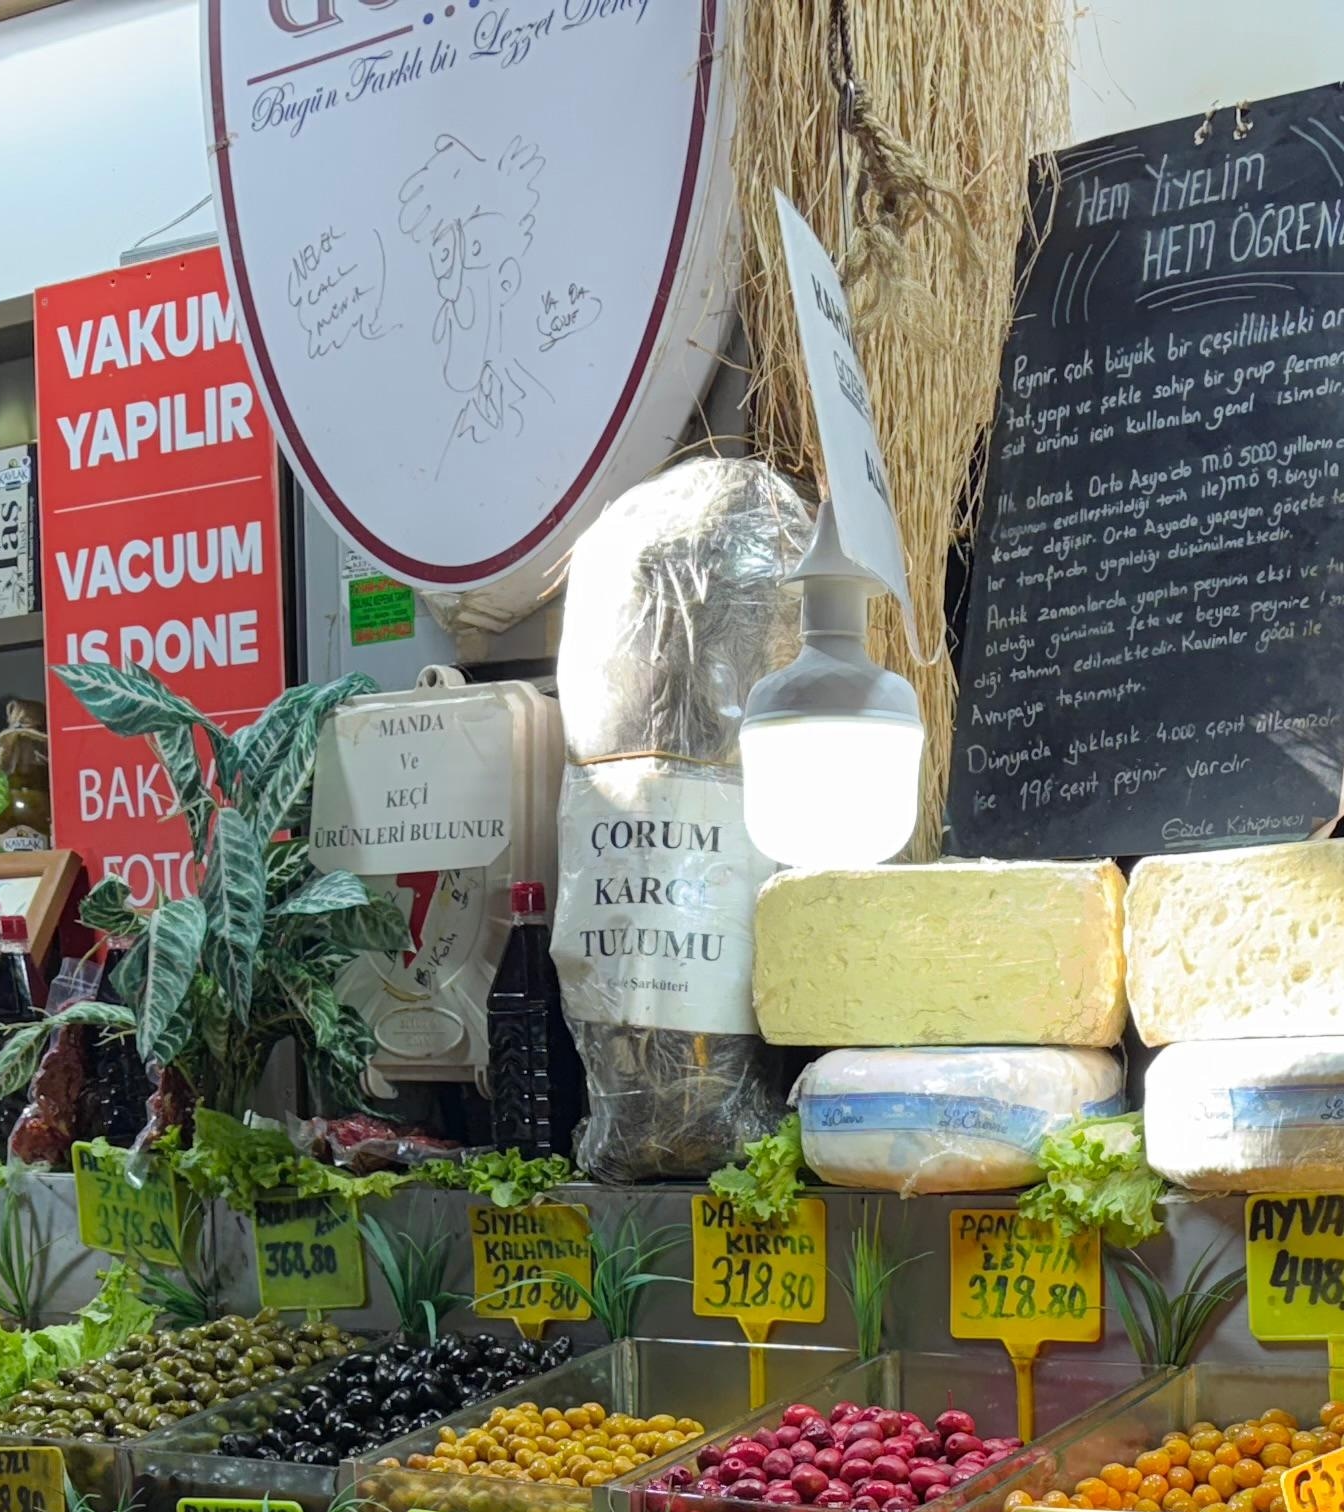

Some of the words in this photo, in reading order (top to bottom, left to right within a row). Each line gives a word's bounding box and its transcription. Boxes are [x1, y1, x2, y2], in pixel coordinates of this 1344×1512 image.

[251, 82, 339, 137] Bugün
[346, 50, 422, 102] Farklı
[431, 41, 457, 77] bir
[470, 8, 555, 68] Lezzet
[1143, 219, 1217, 281] HEM
[1104, 336, 1156, 380] büyük
[1167, 332, 1193, 363] bir
[1075, 397, 1093, 418] ve
[1100, 385, 1143, 418] şekle
[1152, 377, 1196, 405] sahip
[1203, 364, 1225, 391] bir
[1226, 357, 1278, 398] grup
[56, 381, 253, 470] YAPILIR
[1125, 407, 1203, 437] kullanılan
[1204, 391, 1256, 433] genel
[1087, 471, 1125, 500] Orta
[1102, 525, 1138, 546] Orta
[56, 521, 263, 600] VACUUM
[984, 604, 1029, 634] Antik
[1299, 562, 1320, 580] ve
[120, 609, 259, 673] DONE
[984, 636, 1036, 664] olduğu
[1125, 612, 1161, 643] feta
[1164, 609, 1185, 629] ve
[1194, 600, 1242, 631] beyaz
[1180, 627, 1249, 655] Kavimler
[378, 713, 445, 738] MANDA
[400, 752, 419, 770] Ve
[386, 782, 429, 810] KEÇİ
[314, 820, 406, 849] ÜRÜNLERİ
[410, 819, 505, 842] BULUNUR
[590, 818, 723, 860] ÇORUM
[578, 927, 727, 965] TULUMU
